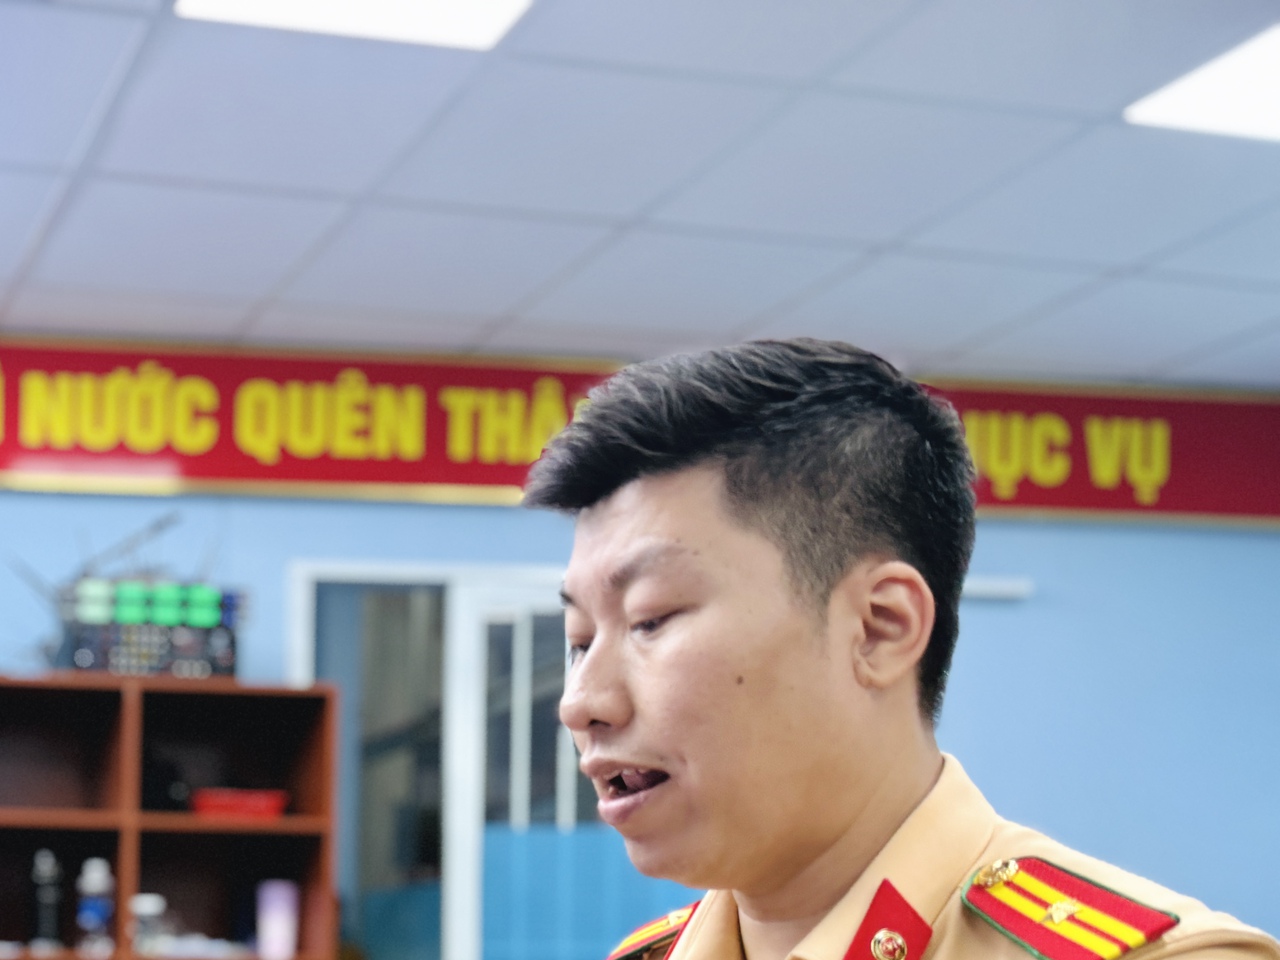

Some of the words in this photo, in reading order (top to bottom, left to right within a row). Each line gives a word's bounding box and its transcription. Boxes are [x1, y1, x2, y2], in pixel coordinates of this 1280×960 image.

[19, 360, 220, 455] NƯỚC
[233, 368, 426, 465] QUÊN
[439, 376, 590, 464] THÂ
[1083, 415, 1170, 506] VỤ
